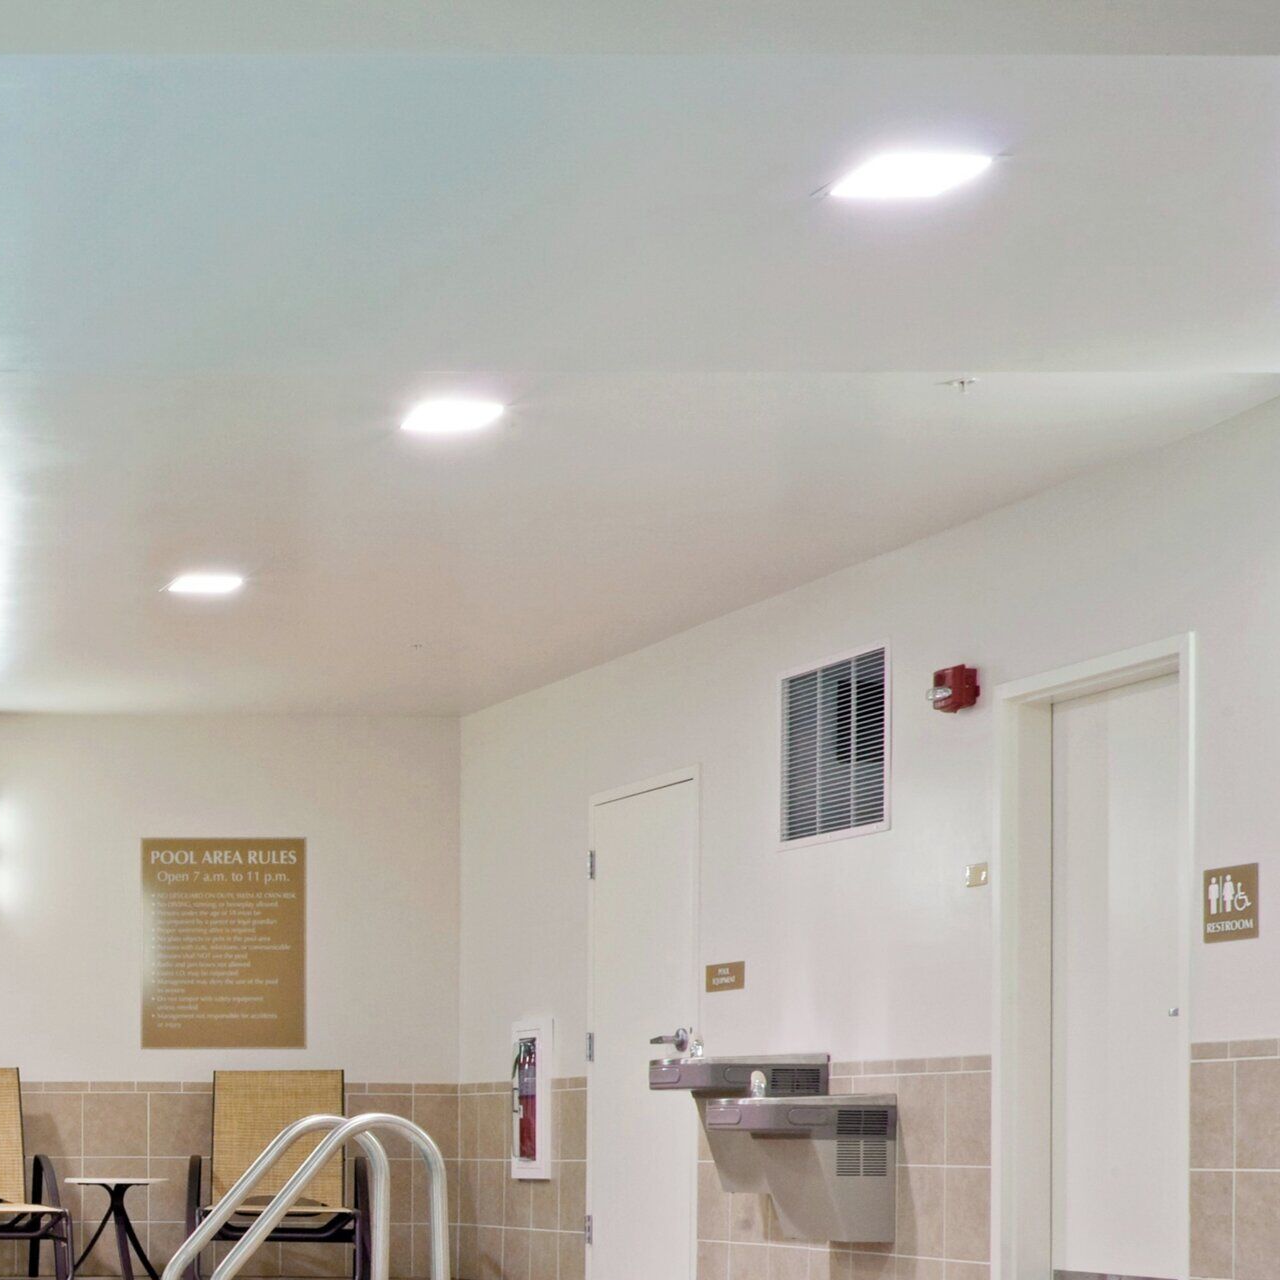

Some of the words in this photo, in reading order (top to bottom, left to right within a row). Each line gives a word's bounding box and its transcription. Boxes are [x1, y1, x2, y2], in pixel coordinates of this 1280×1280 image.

[150, 850, 197, 865] POOL
[201, 850, 243, 865] AREA
[247, 850, 297, 865] RULES
[157, 870, 189, 885] Open
[192, 871, 200, 882] 7
[202, 873, 227, 882] a.m.
[231, 872, 243, 882] to
[247, 871, 259, 882] 11
[264, 873, 290, 885] p.m.
[1206, 919, 1254, 934] RESTROOM
